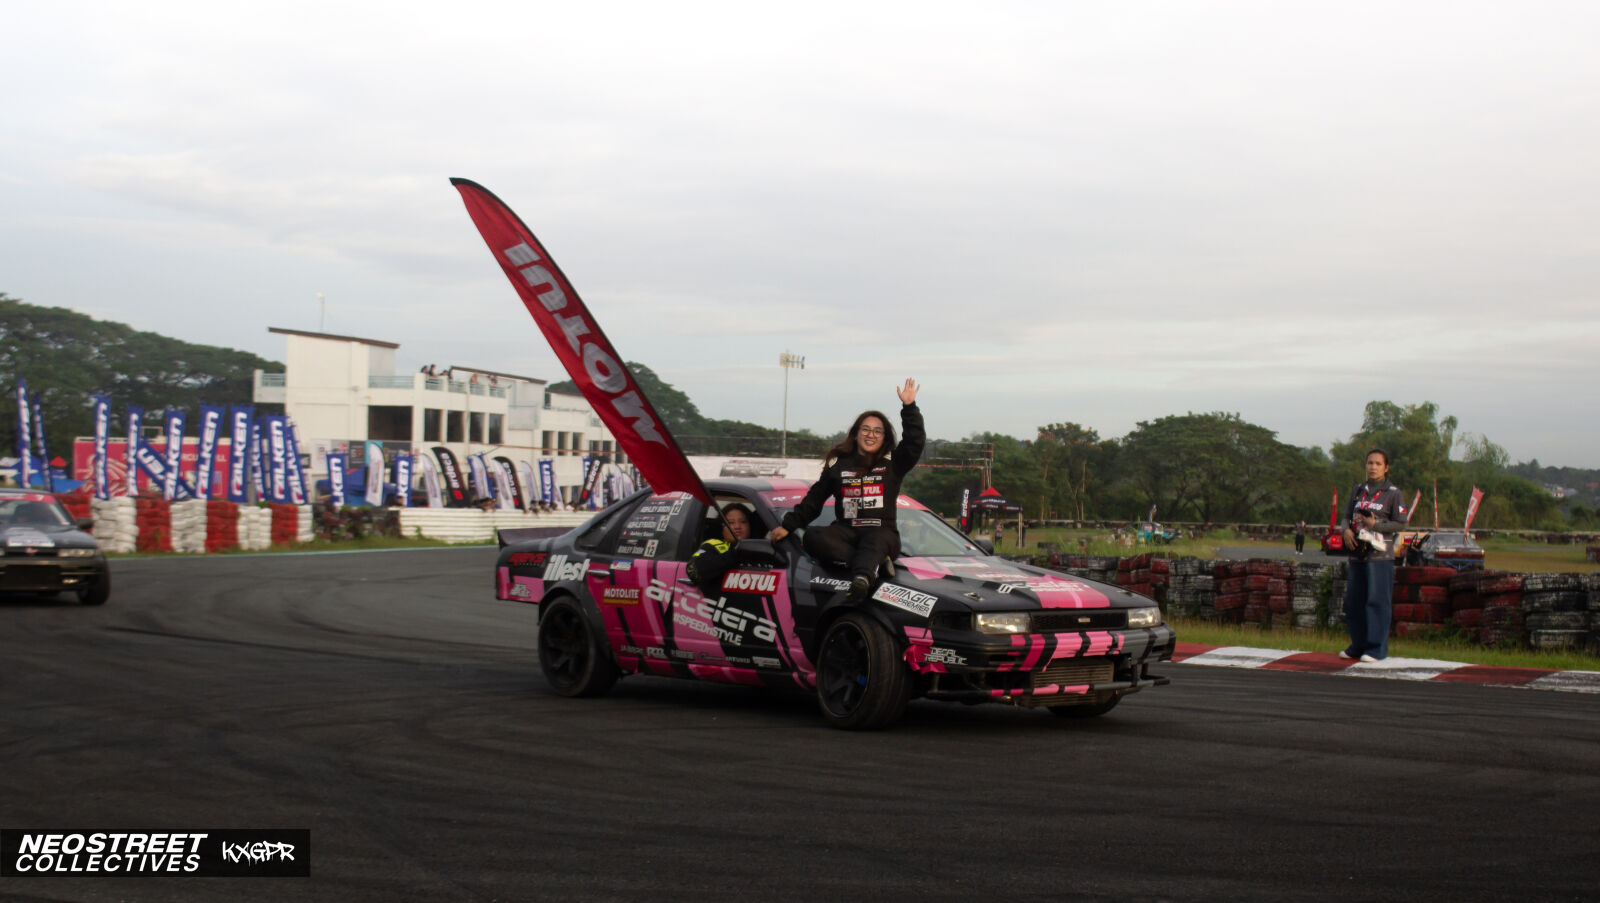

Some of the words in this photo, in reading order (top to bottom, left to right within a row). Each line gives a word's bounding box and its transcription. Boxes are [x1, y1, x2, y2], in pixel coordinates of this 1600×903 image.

[503, 233, 670, 449] MOTUL
[196, 411, 220, 499] FALKEN
[231, 412, 248, 496] FALKEN
[270, 420, 286, 500] FALKEN
[542, 554, 591, 581] illest
[603, 587, 640, 599] MOTOLITE
[724, 572, 777, 592] MOTUL
[883, 585, 936, 607] SIMAGIC
[645, 578, 778, 643] accelera
